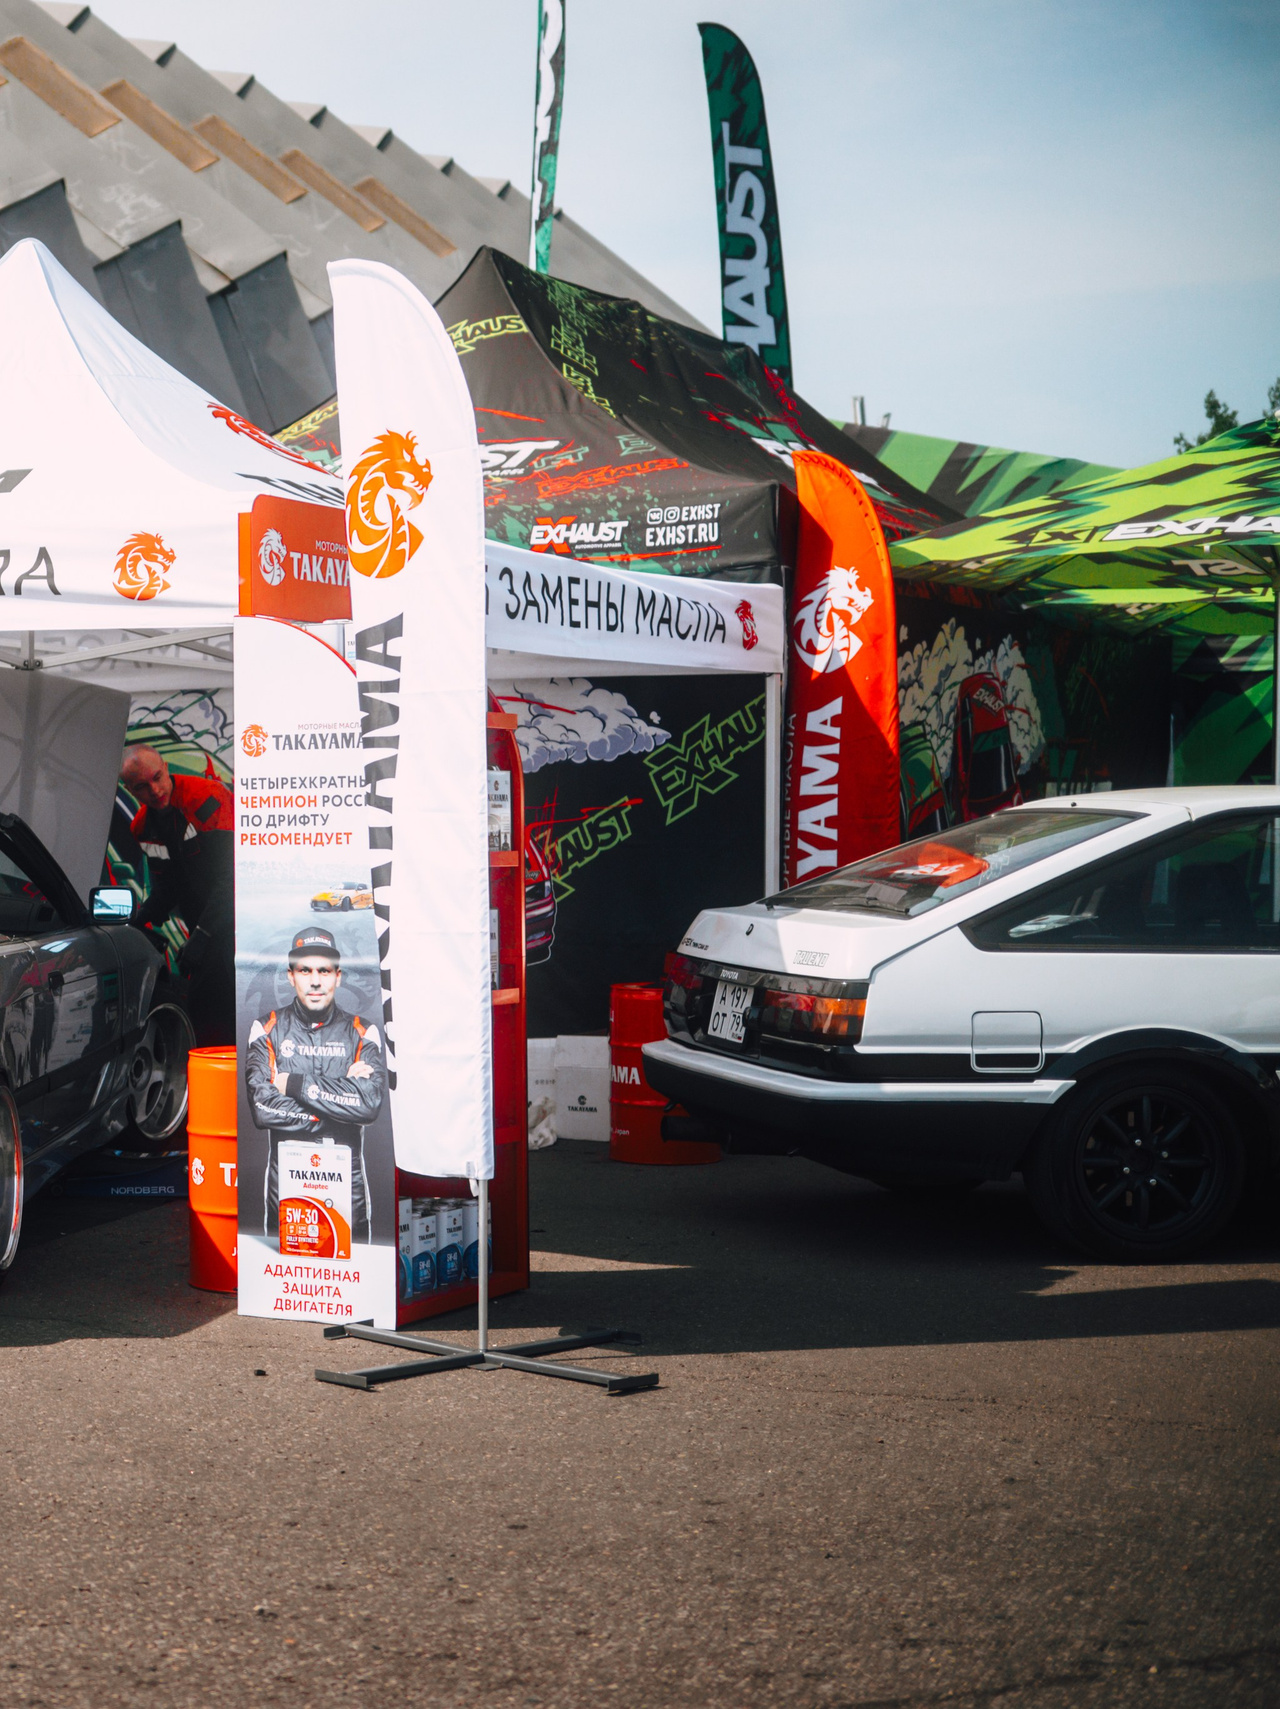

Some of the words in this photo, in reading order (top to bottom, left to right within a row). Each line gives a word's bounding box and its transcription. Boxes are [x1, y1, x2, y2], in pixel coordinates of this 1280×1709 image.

[681, 503, 721, 522] EXHST
[530, 520, 629, 546] EXHAUST
[645, 522, 719, 547] EXHST.RU
[1102, 515, 1280, 542] EXHA
[498, 567, 626, 633] ЗАМЕНЫ
[636, 586, 726, 643] МАСЛА
[298, 722, 337, 731] МОТОРНЫЕ
[339, 722, 363, 730] МАСЛ
[797, 696, 843, 879] YAMA
[240, 795, 317, 809] ЧЕМПИОН
[240, 814, 262, 828] ПО
[266, 813, 330, 829] ДРИФТУ
[240, 832, 353, 847] РЕКОМЕНДУЕТ
[793, 950, 829, 967] TRUENO
[720, 969, 739, 981] TOYOTA
[731, 986, 748, 1013] 197
[298, 1045, 345, 1057] TAKAYAMA
[320, 1091, 361, 1107] TAKAYAMA
[287, 1111, 309, 1119] AUTO
[289, 1169, 343, 1183] TAKAYAMA
[111, 1186, 175, 1195] NORDBERG
[303, 1182, 329, 1190] Adaptec
[286, 1207, 319, 1225] 5W-30
[264, 1263, 360, 1283] АДАПТИВНАЯ
[282, 1282, 342, 1298] ЗАЩИТА
[274, 1297, 353, 1317] ДВИГАТЕЛЯ
